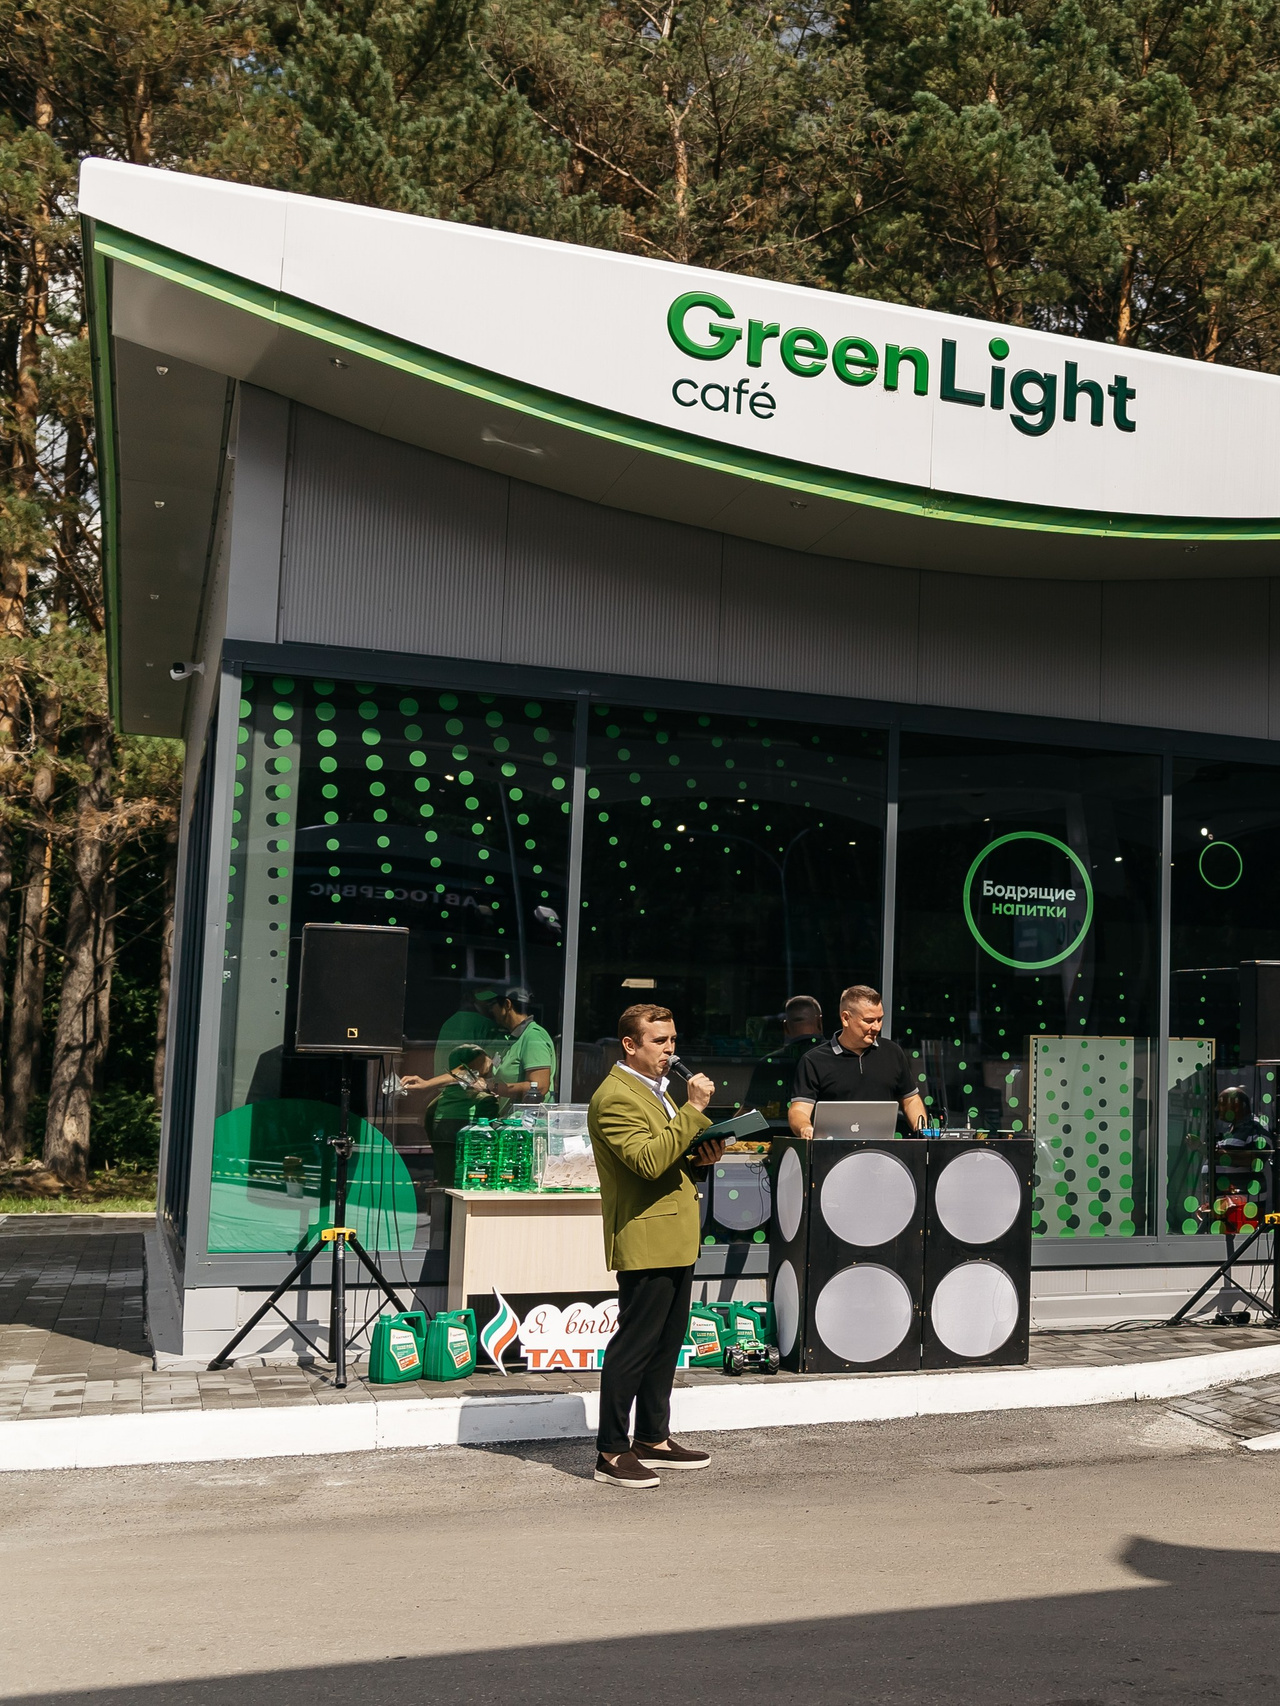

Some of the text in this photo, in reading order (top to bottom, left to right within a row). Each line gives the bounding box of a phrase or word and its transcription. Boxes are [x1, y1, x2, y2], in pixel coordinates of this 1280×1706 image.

[667, 290, 1136, 437] GreenLight
[671, 377, 777, 420] café
[983, 880, 1077, 902] Бодрящие
[992, 903, 1067, 918] напитки
[528, 1311, 550, 1334] Я
